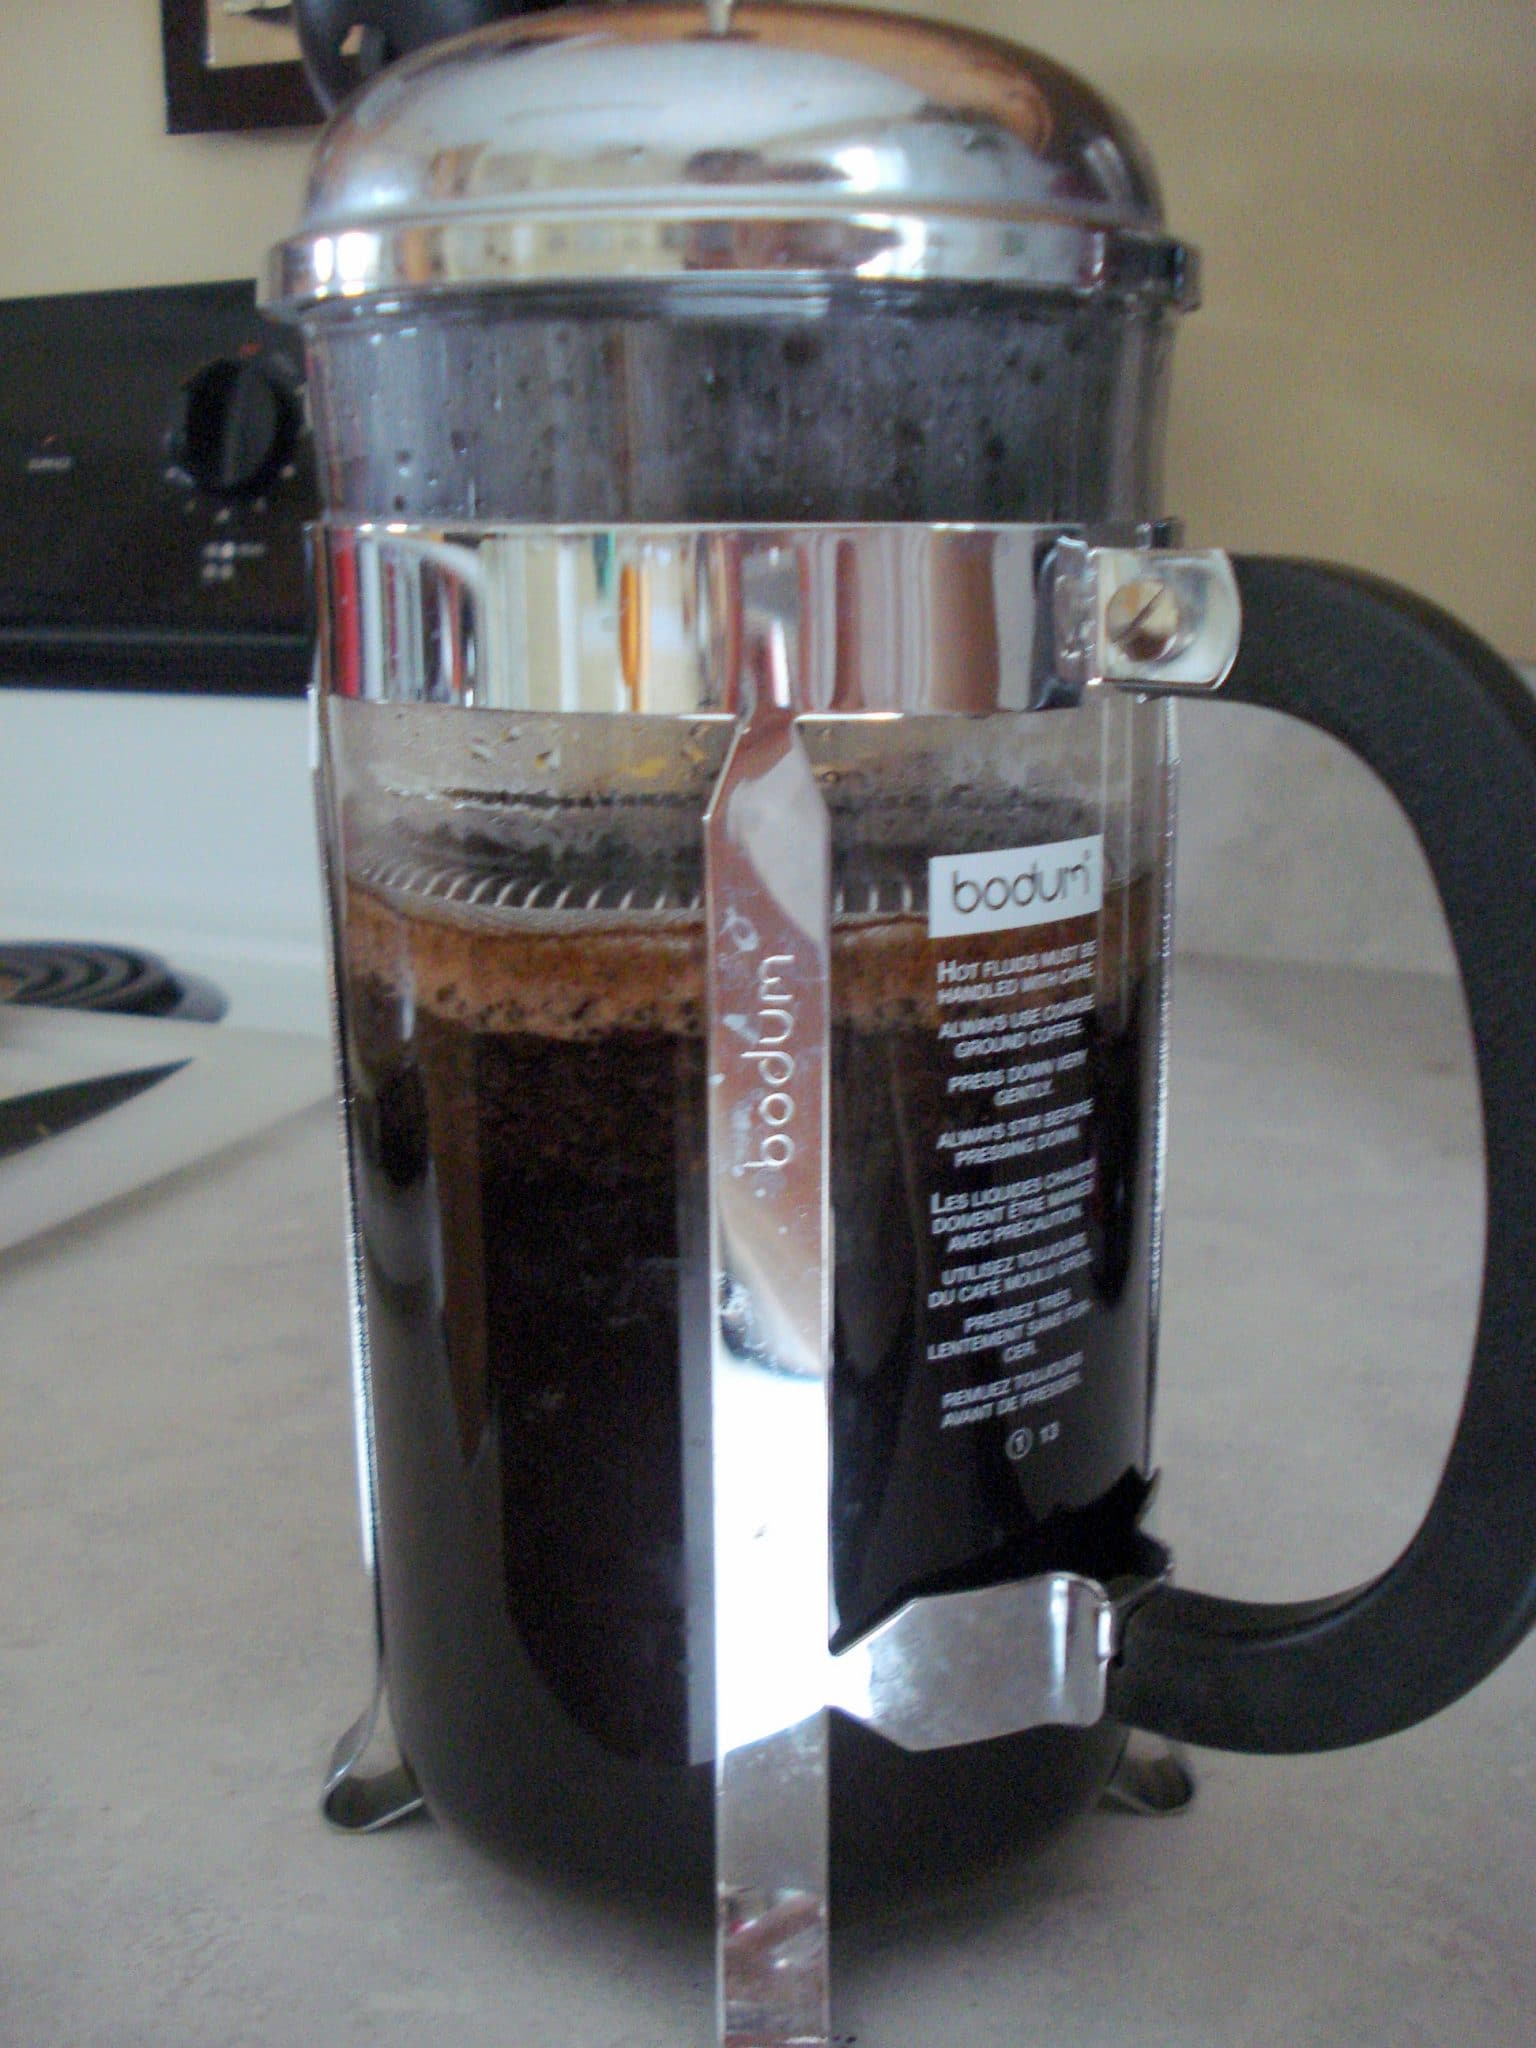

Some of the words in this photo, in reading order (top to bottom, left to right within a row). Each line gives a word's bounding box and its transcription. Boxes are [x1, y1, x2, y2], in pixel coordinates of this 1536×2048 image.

[952, 857, 1090, 914] bodum
[937, 960, 981, 983] HOT
[740, 954, 795, 1168] bodum
[931, 1191, 969, 1214] LES
[928, 1287, 956, 1308] DU
